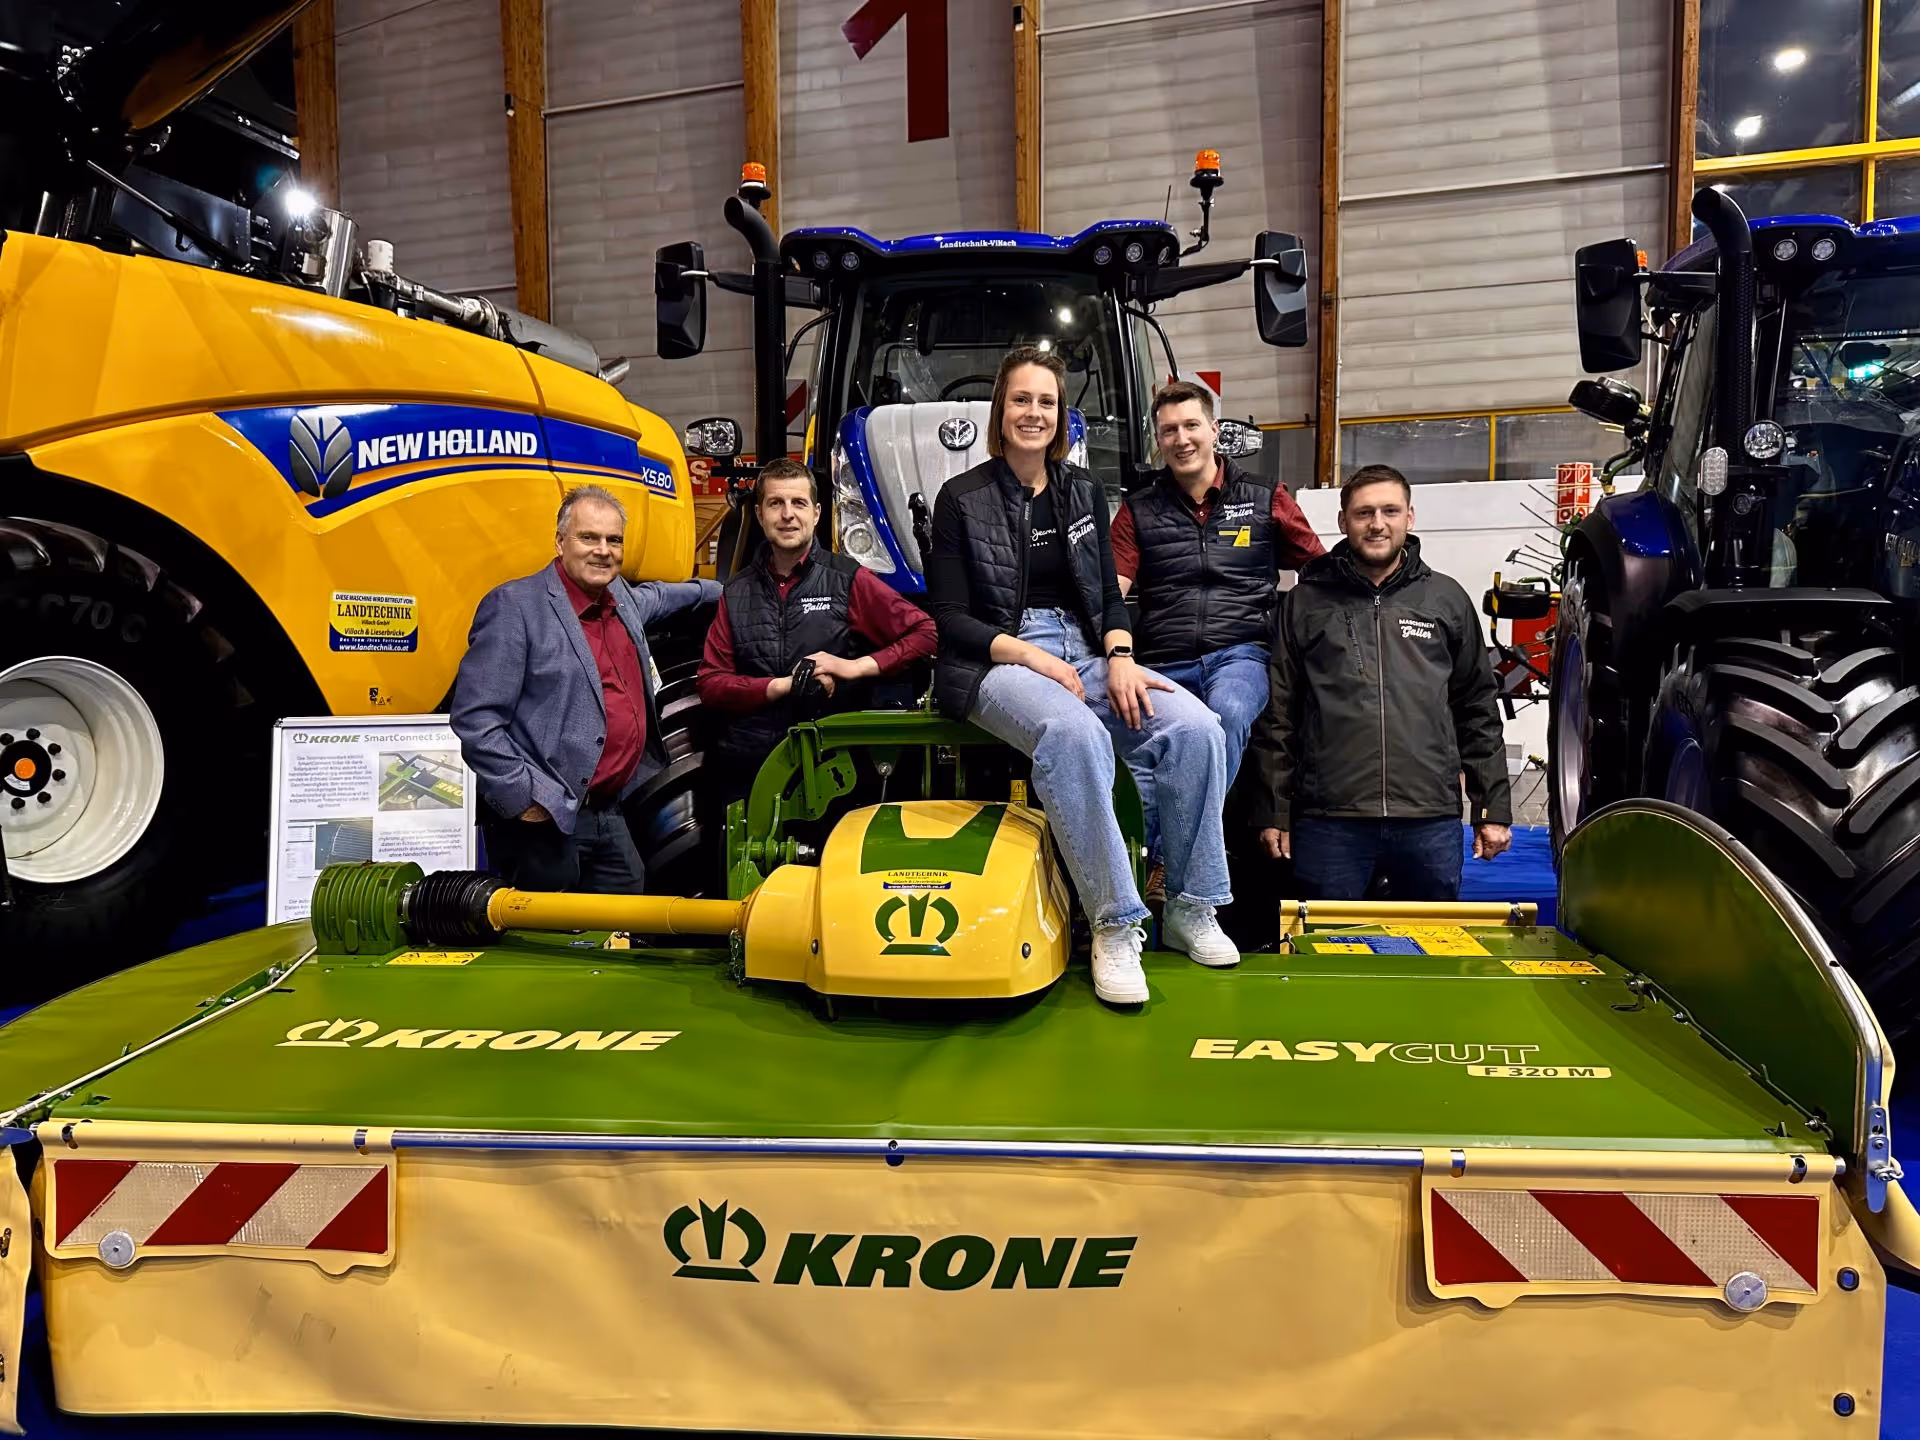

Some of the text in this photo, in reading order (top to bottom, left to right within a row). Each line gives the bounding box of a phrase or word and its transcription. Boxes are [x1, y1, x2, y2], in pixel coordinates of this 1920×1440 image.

[841, 0, 949, 143] 1
[357, 429, 538, 469] NEW HOLLAND
[337, 604, 412, 619] LANDTECHNIK
[1398, 618, 1435, 628] MASCHINEN
[339, 643, 409, 651] www.landtechnik.co.at
[309, 734, 361, 744] KRONE
[364, 733, 433, 742] SmartConnect
[361, 1028, 682, 1051] KRONE
[1190, 1038, 1540, 1064] EASYCUT
[1484, 1067, 1595, 1077] F 320 M
[773, 1232, 1138, 1292] KRONE
